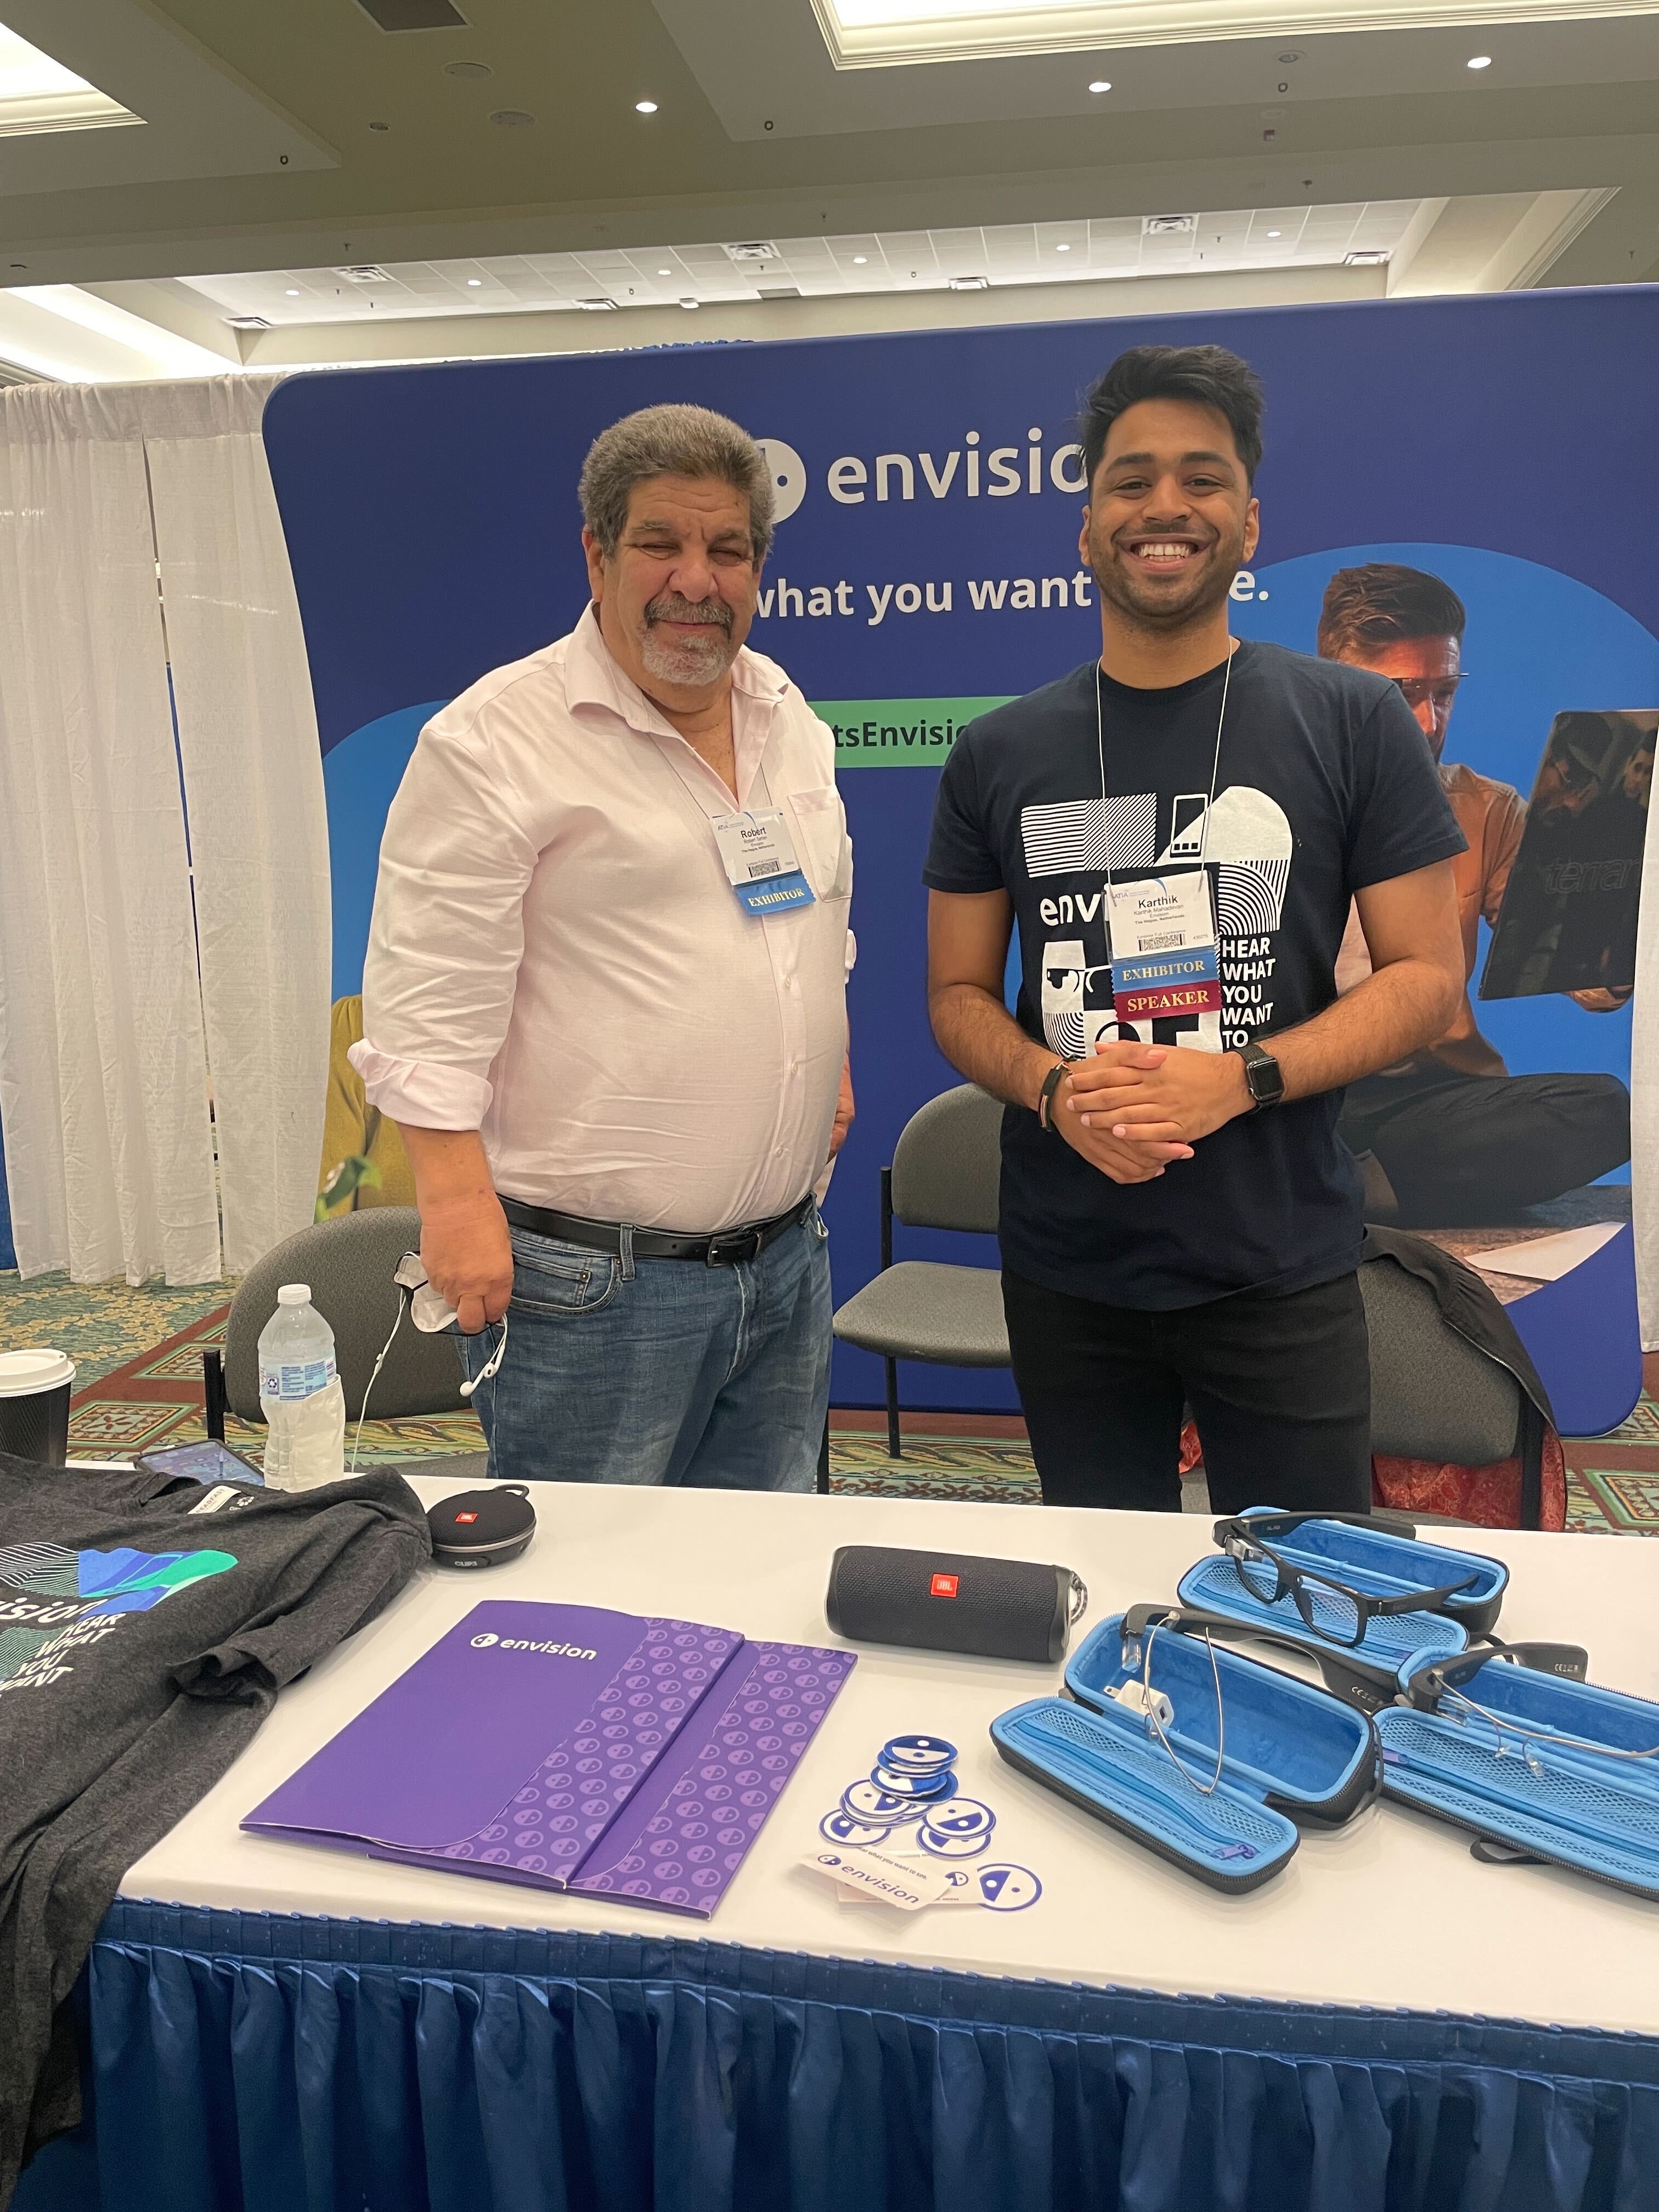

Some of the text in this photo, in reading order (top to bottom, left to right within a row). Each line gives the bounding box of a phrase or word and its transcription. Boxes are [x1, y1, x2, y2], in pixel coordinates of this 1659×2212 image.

[866, 582, 952, 626] you
[967, 570, 1092, 611] want
[741, 827, 767, 839] Robert
[748, 888, 805, 907] EXHIBITOR
[1138, 895, 1178, 909] Karthik
[1222, 937, 1271, 958] HEAR
[1122, 960, 1205, 981] EXHIBITOR
[1222, 958, 1276, 981] WHAT
[1127, 990, 1210, 1012] SPEAKER
[1222, 984, 1262, 1004] YOU
[1222, 1002, 1274, 1025] WANT
[1222, 1030, 1249, 1049] TO
[63, 1613, 126, 1638] HEAR
[35, 1628, 116, 1658] WHAT
[500, 1639, 597, 1661] envision
[12, 1649, 70, 1678] YOU
[841, 1865, 919, 1904] envision
